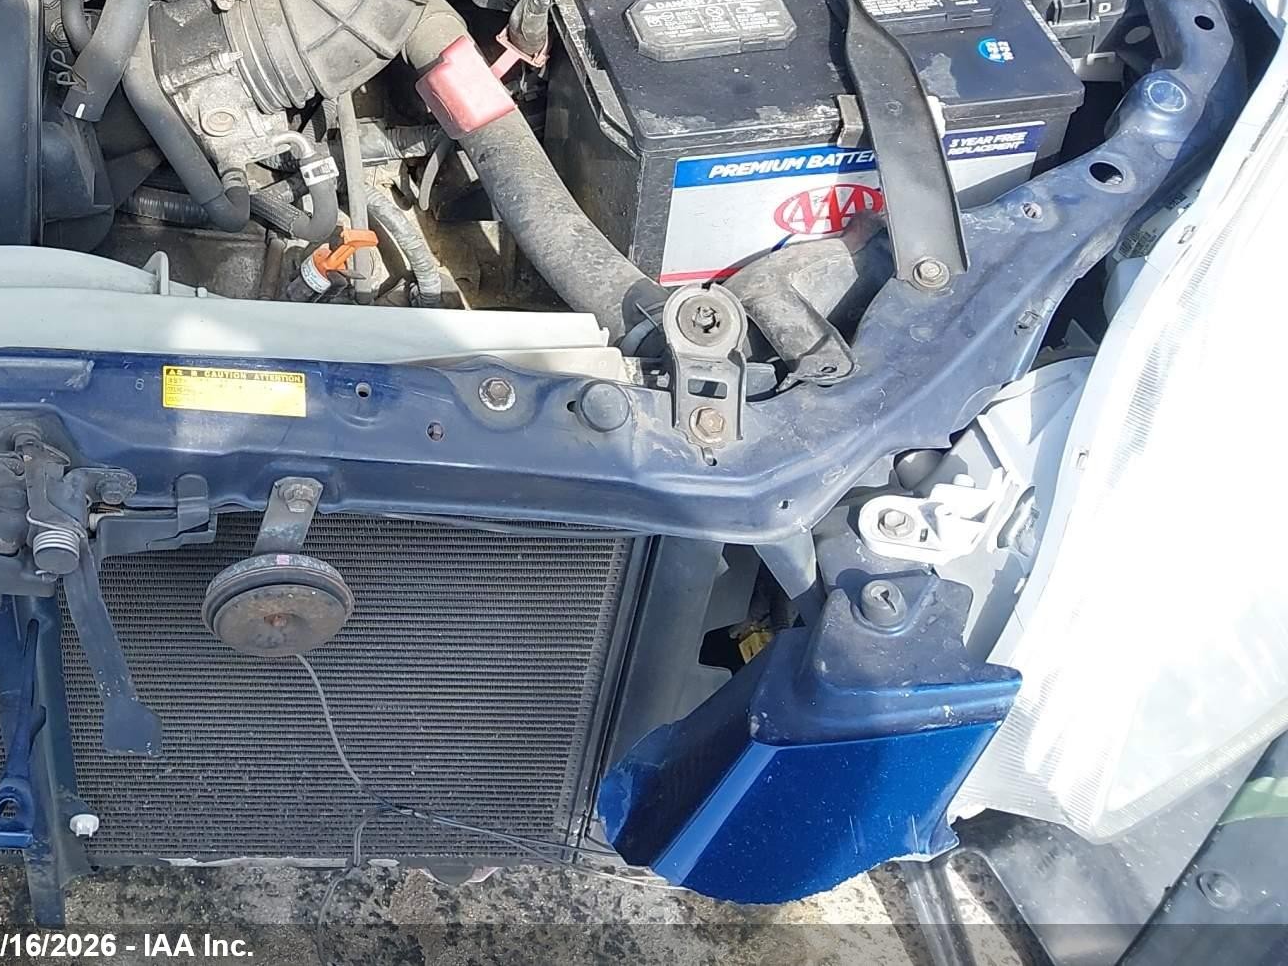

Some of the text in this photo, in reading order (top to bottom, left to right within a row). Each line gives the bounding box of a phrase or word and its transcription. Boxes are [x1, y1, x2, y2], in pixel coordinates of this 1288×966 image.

[949, 131, 1028, 148] 3 YEAR FREE
[947, 140, 1025, 156] REPLACEMENT
[708, 155, 803, 179] PREMIUM
[204, 369, 248, 380] CAUTION
[253, 372, 302, 384] ATTENTION
